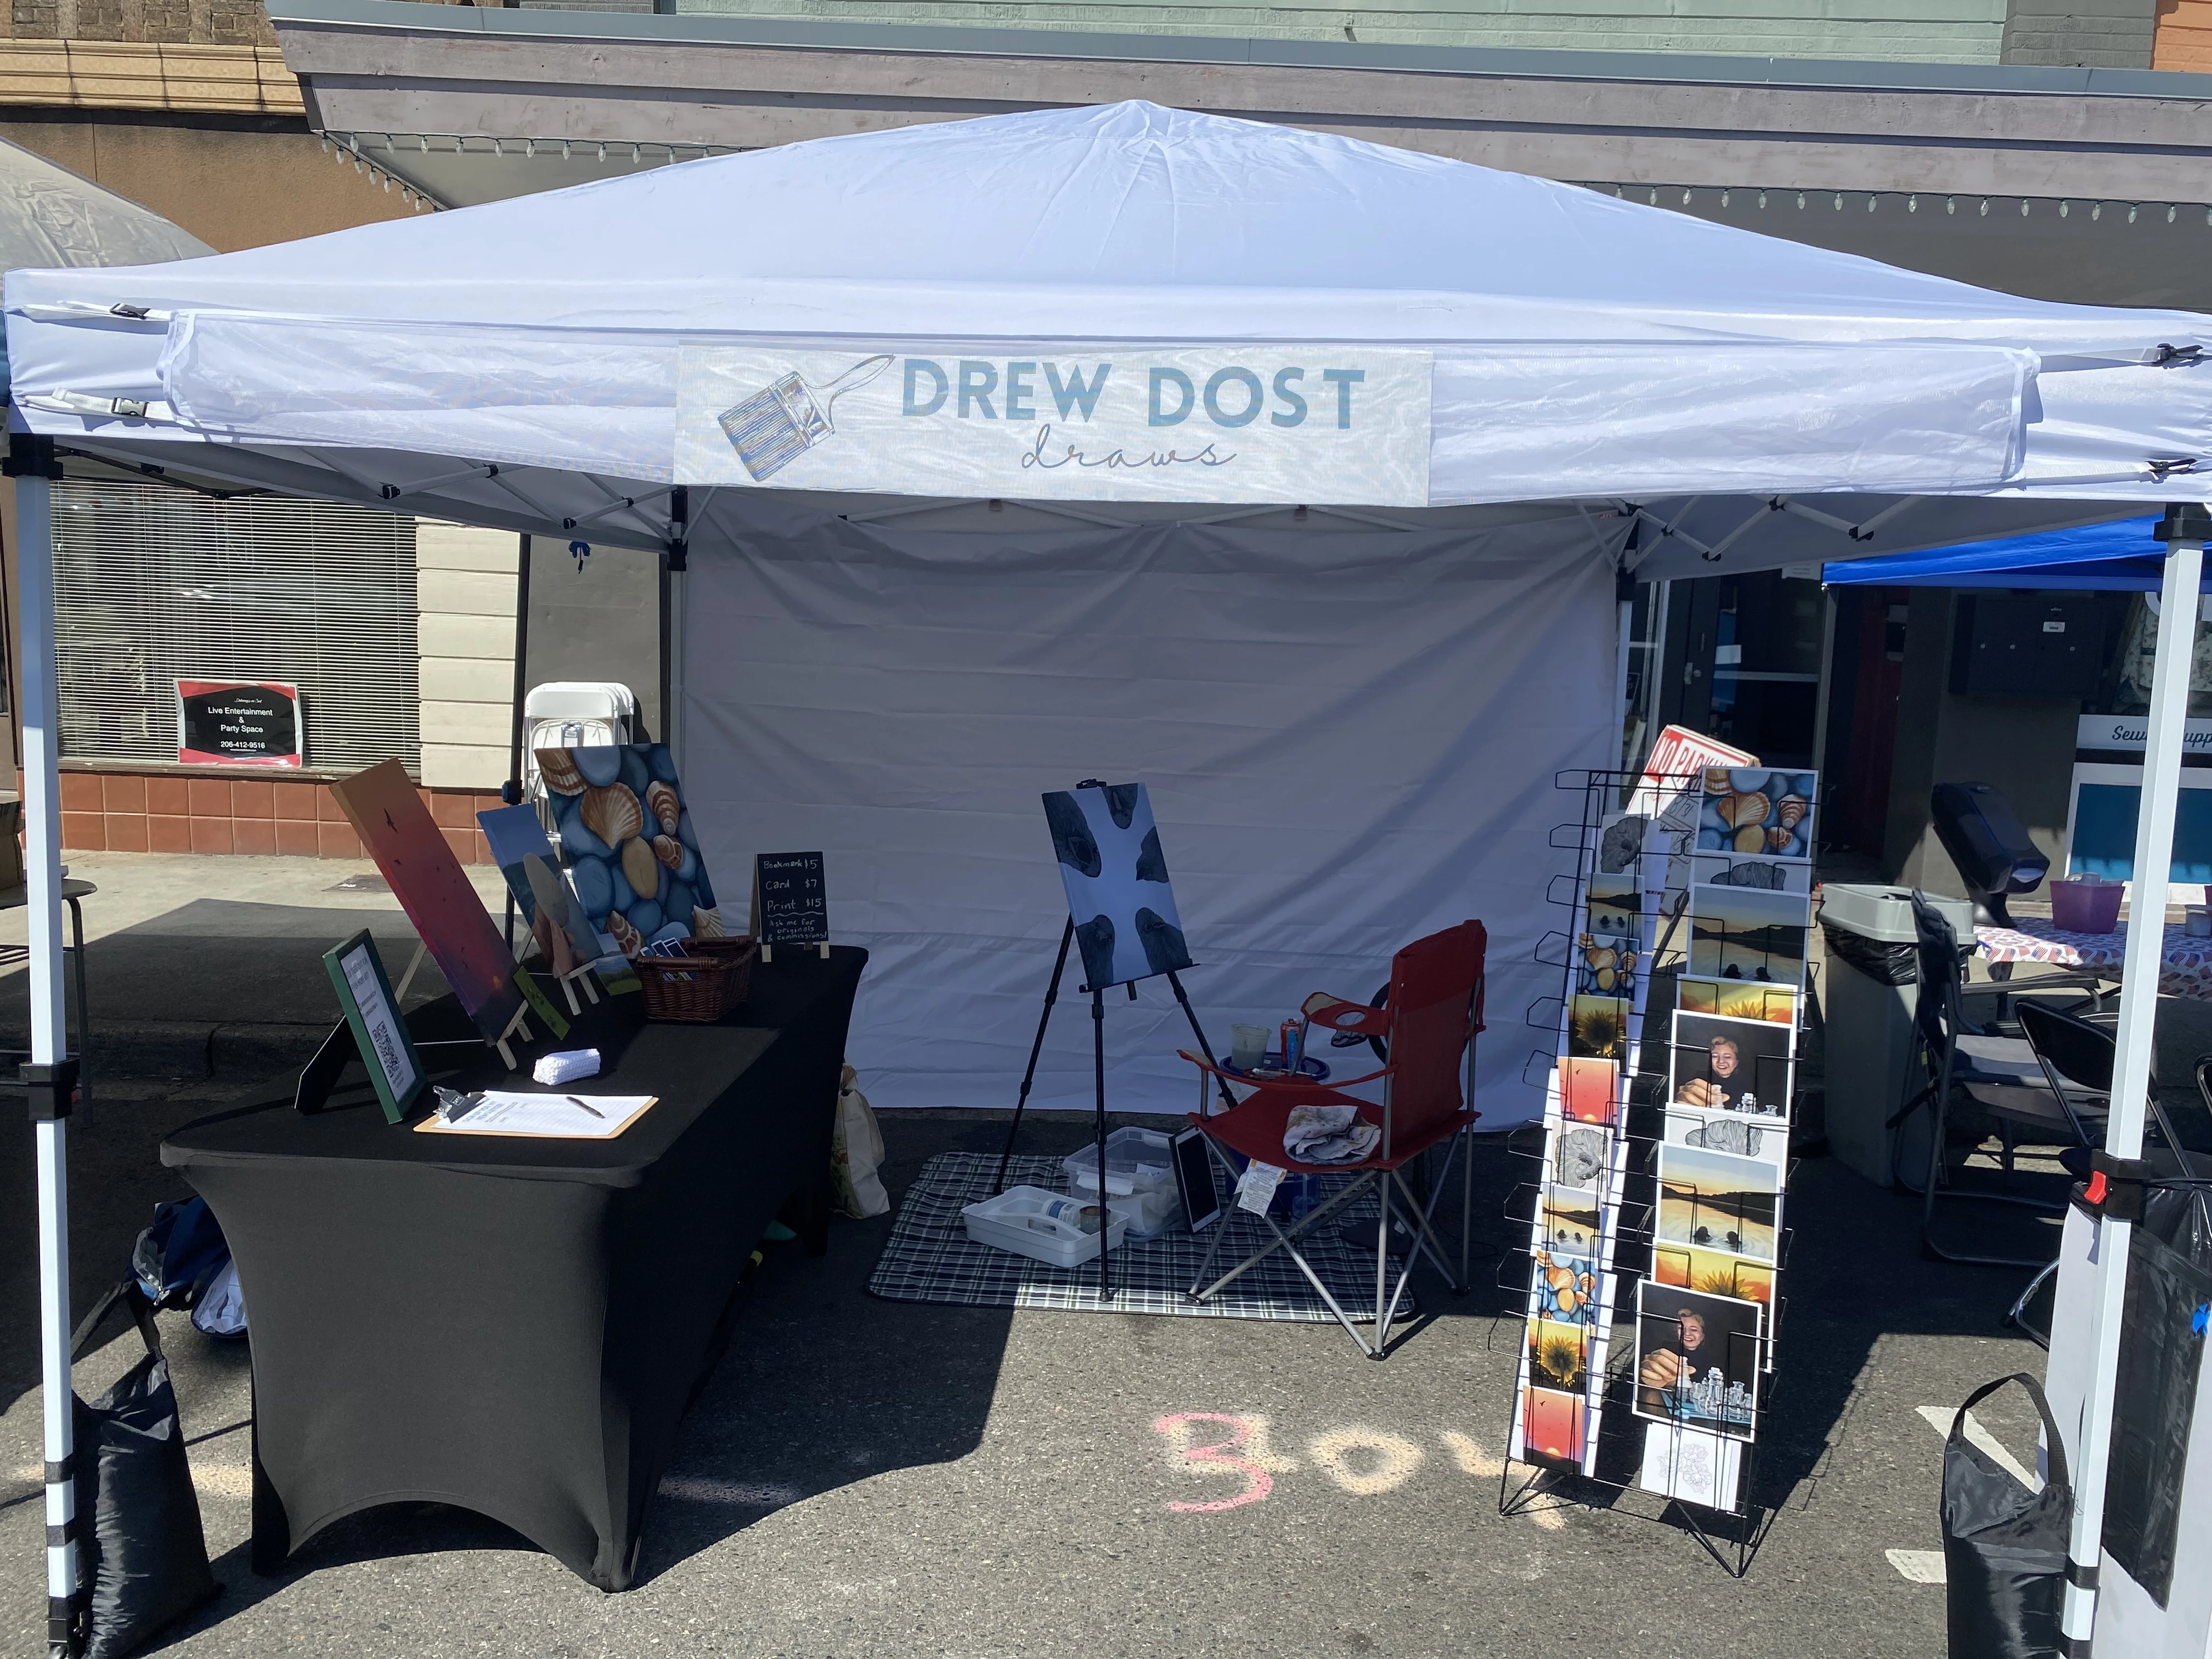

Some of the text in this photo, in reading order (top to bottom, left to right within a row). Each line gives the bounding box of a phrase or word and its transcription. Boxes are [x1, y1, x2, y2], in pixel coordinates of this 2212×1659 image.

[902, 359, 1365, 430] DREW DOST
[1022, 423, 1237, 469] draws
[224, 707, 273, 716] Entertainment
[221, 724, 263, 733] Party Space
[2112, 725, 2147, 741] Sew
[1650, 737, 1677, 774] NO
[764, 859, 819, 870] Bookmark $5
[765, 878, 817, 890] Card $7
[767, 898, 822, 911] Print $15
[777, 926, 815, 934] originals
[768, 934, 774, 942] &
